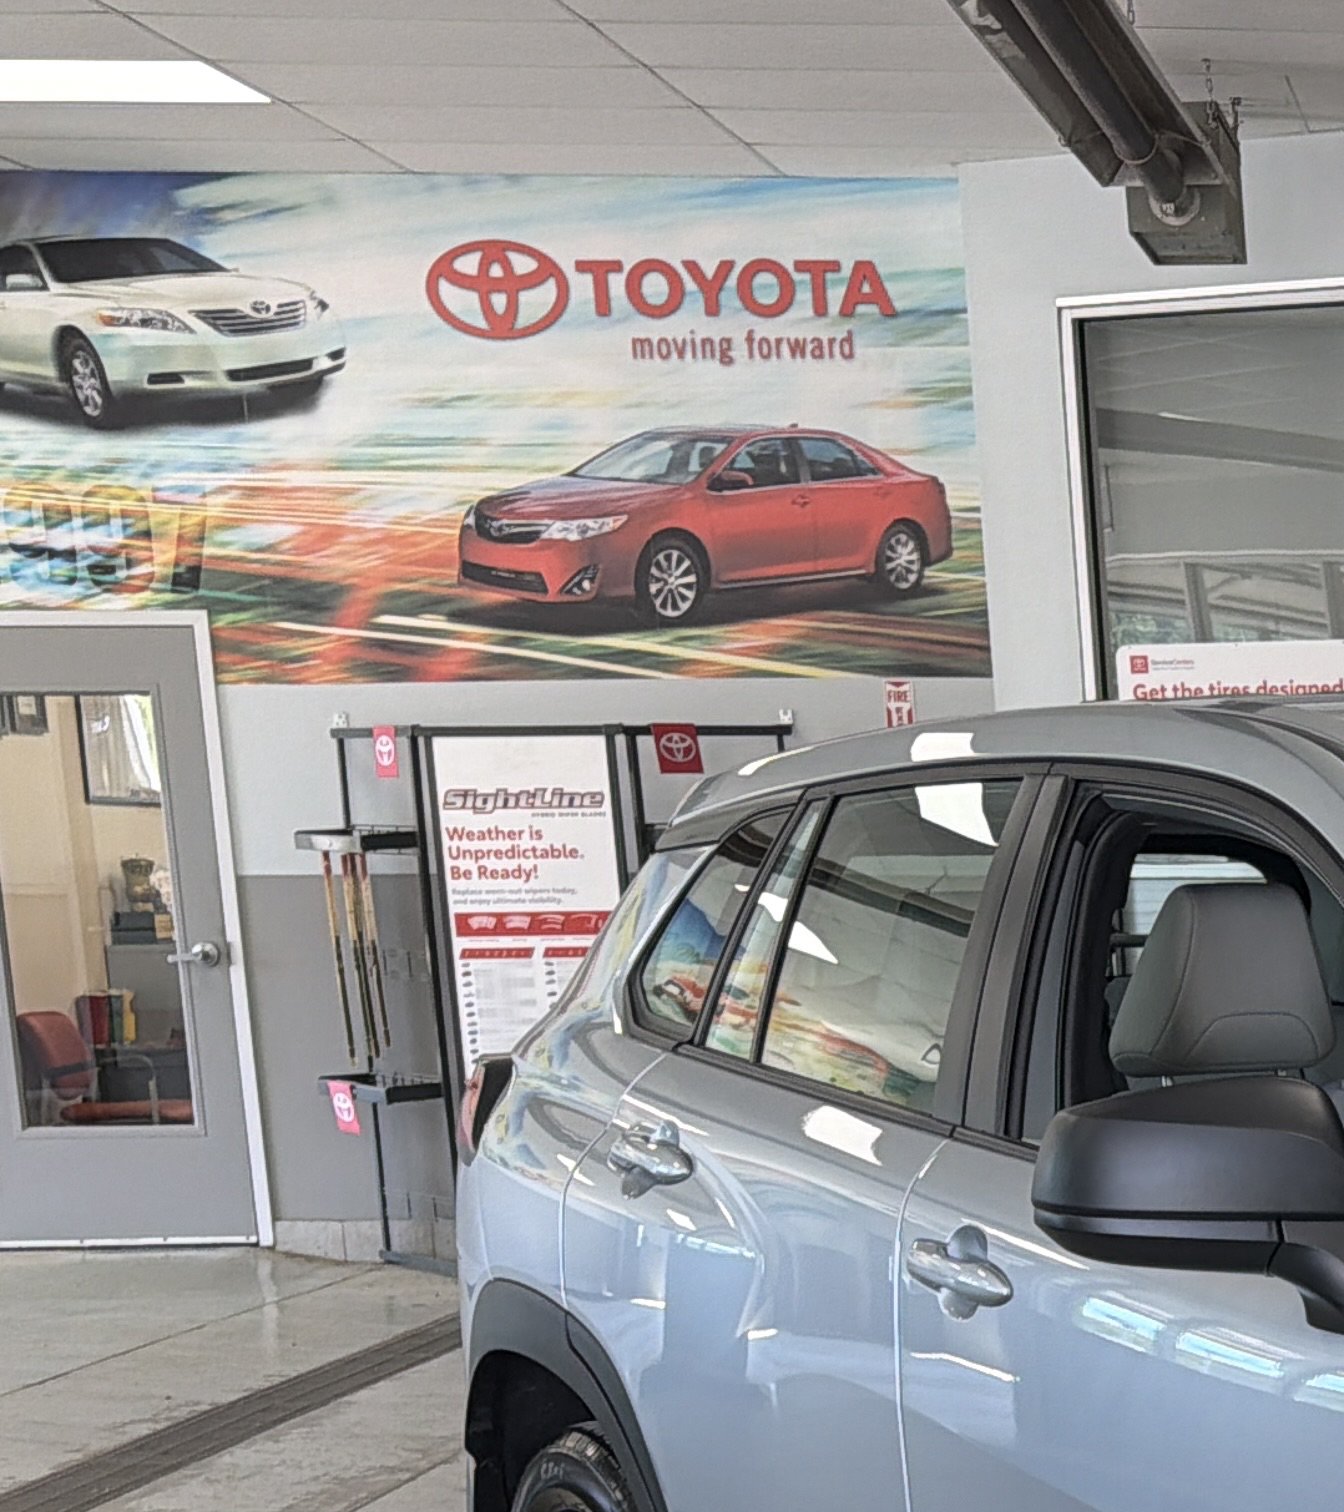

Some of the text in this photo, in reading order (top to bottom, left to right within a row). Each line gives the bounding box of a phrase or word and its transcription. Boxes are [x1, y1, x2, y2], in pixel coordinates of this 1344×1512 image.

[576, 259, 896, 318] TOYOTA
[631, 328, 856, 366] moving forward
[1133, 678, 1344, 700] Get the tires designed
[444, 788, 604, 814] SightLine
[445, 825, 543, 842] Weather is
[448, 844, 585, 864] Unpredictable.
[450, 864, 539, 883] Be Ready!
